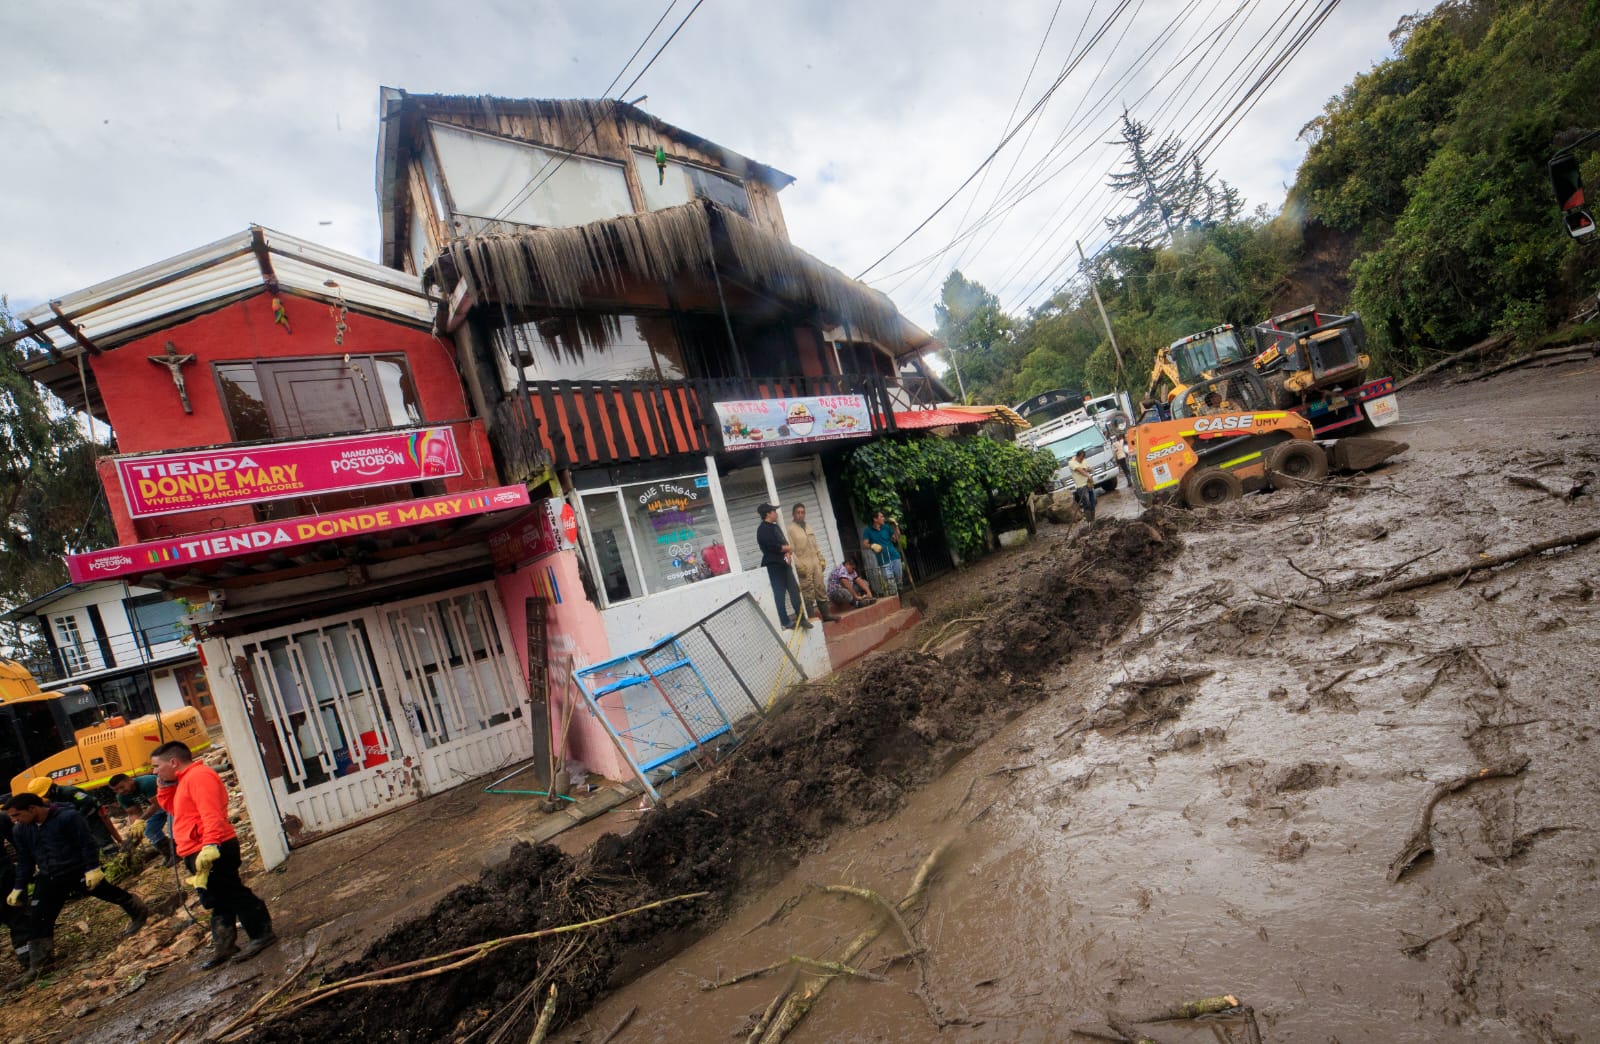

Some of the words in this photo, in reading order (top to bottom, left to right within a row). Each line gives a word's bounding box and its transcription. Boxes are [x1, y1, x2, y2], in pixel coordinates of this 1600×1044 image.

[1194, 415, 1253, 432] CASE
[1255, 418, 1280, 427] UMV
[341, 447, 384, 459] MANZANA
[1146, 443, 1185, 462] SR200
[132, 456, 259, 478] TIENDA
[138, 471, 230, 499] DONDE
[235, 464, 298, 488] MARY
[144, 495, 193, 506] VIVERES
[203, 489, 251, 500] RANCHO
[260, 482, 304, 493] LICORES
[640, 487, 657, 504] QUE
[659, 484, 698, 500] TENGAS
[180, 528, 293, 558] TIENDA
[297, 511, 391, 540] DONDE
[398, 499, 463, 523] MARY
